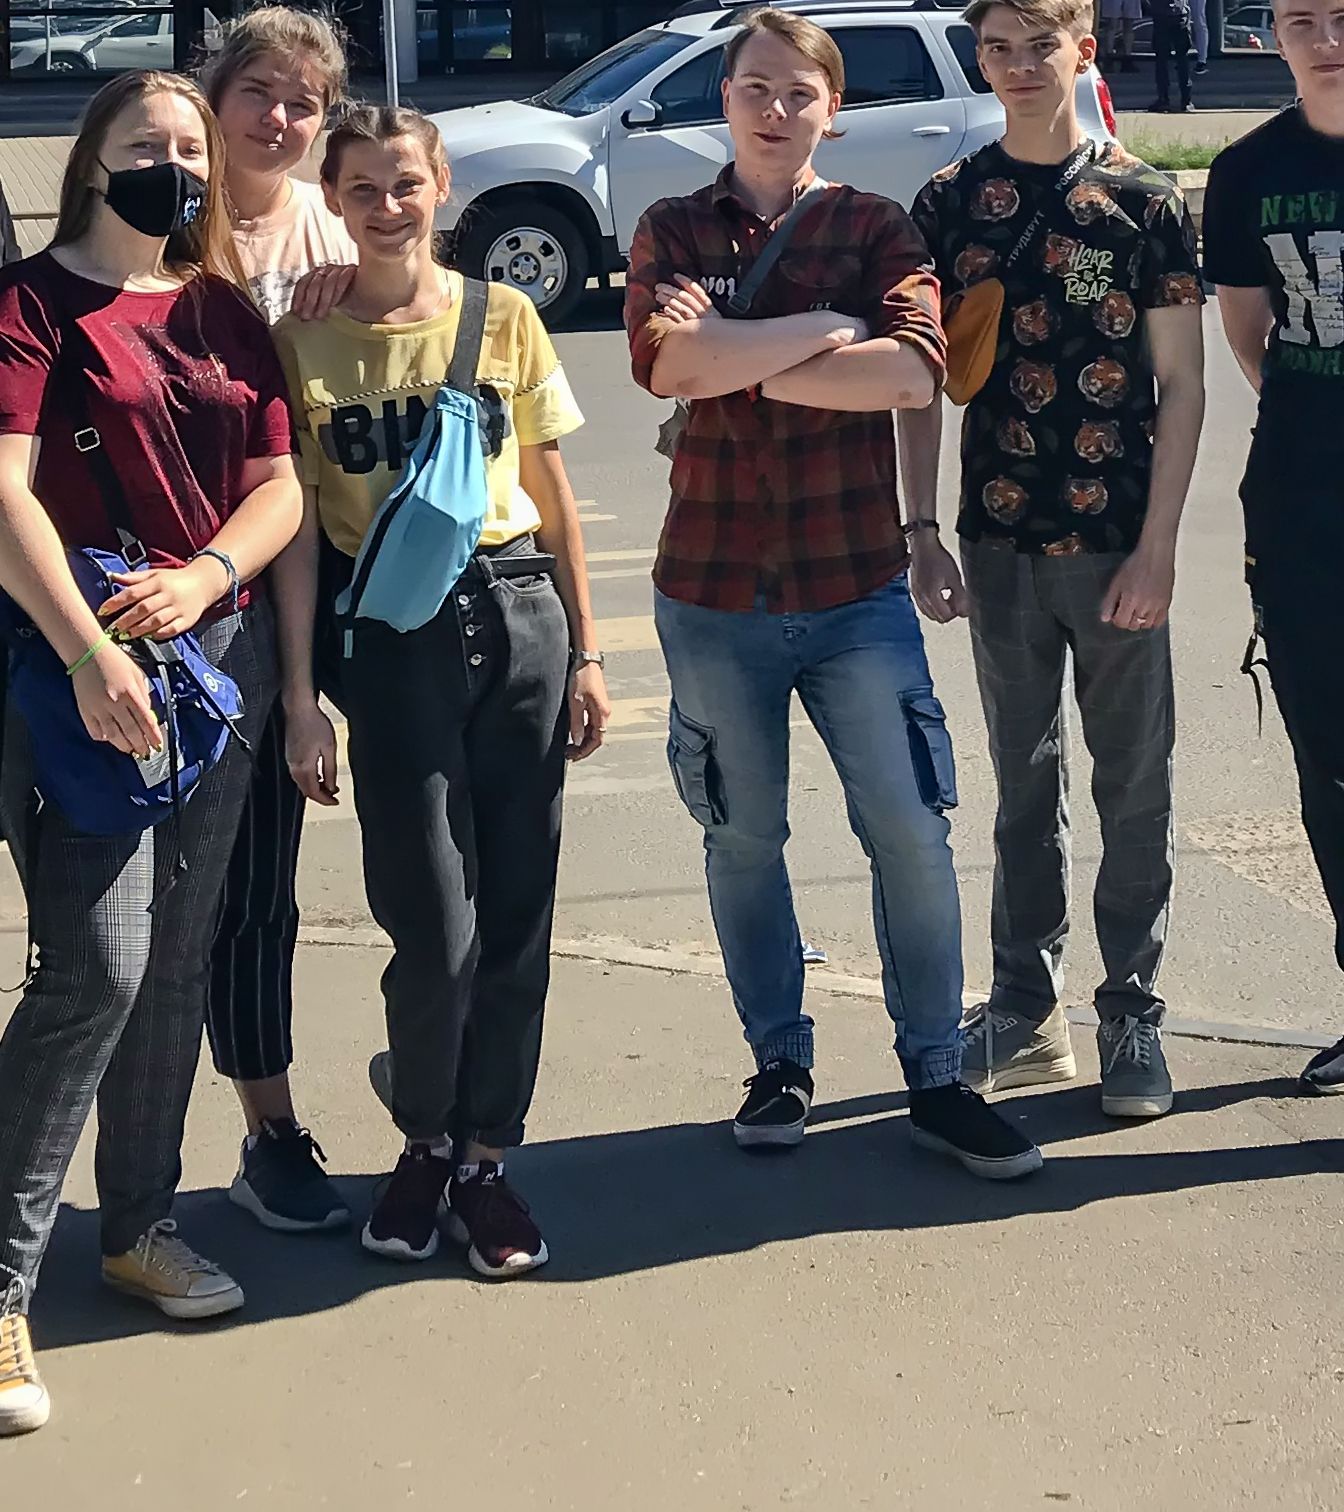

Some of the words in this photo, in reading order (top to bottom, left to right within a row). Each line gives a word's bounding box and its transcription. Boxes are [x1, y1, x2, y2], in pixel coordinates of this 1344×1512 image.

[1260, 194, 1337, 227] NEW
[1068, 243, 1114, 275] HEAR
[1064, 277, 1109, 303] ROAR
